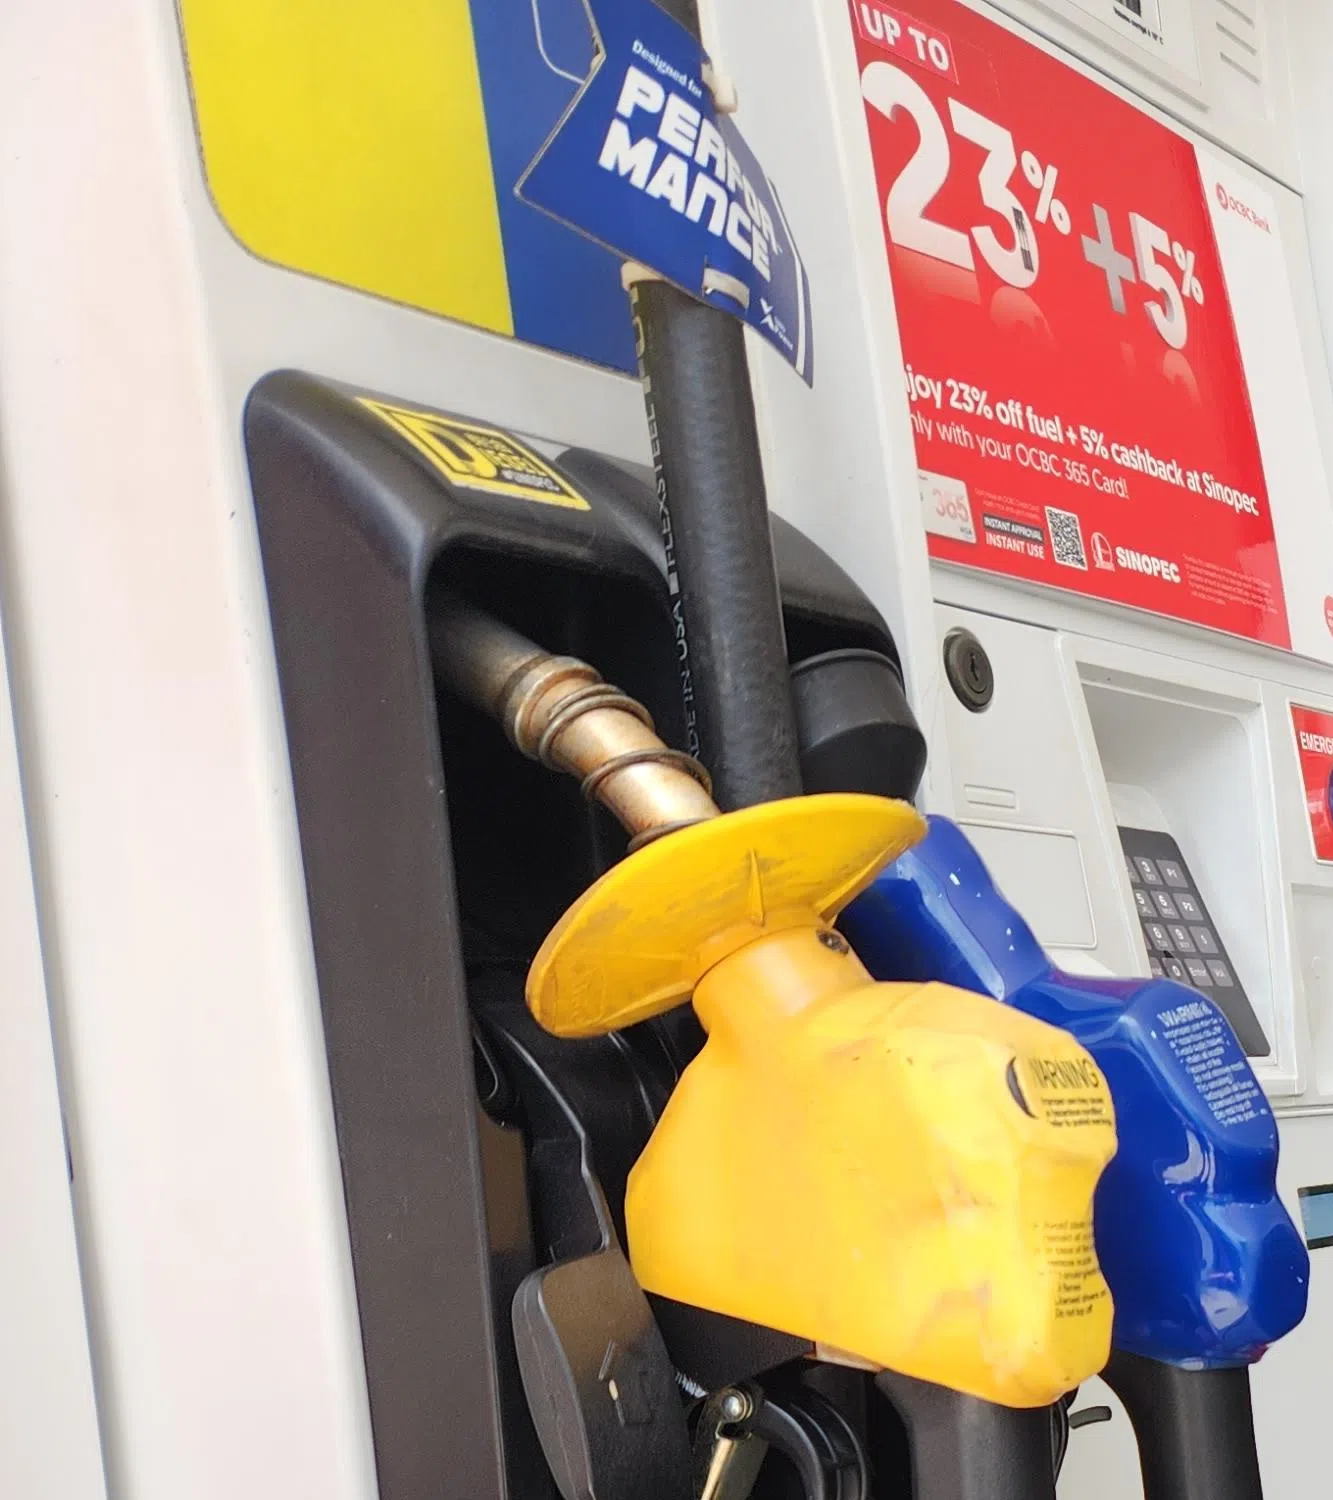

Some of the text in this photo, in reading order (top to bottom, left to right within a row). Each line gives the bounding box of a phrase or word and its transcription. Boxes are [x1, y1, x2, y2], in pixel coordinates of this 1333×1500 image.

[632, 39, 688, 89] Designed
[861, 0, 950, 71] UP TO
[598, 118, 771, 283] MANCE
[860, 60, 1072, 290] 23%
[909, 409, 1131, 500] nly with your OCBC 365 Card!
[945, 378, 994, 420] 23%
[995, 398, 1025, 431] off
[1026, 404, 1063, 442] fuel
[1066, 431, 1077, 447] +
[1080, 425, 1109, 459] 5%
[1111, 437, 1185, 487] cashback
[1186, 470, 1203, 495] at
[1201, 472, 1261, 517] Sinopec
[985, 531, 1026, 556] INSTANT
[1027, 542, 1046, 561] USE
[1116, 545, 1182, 584] SINOPEC
